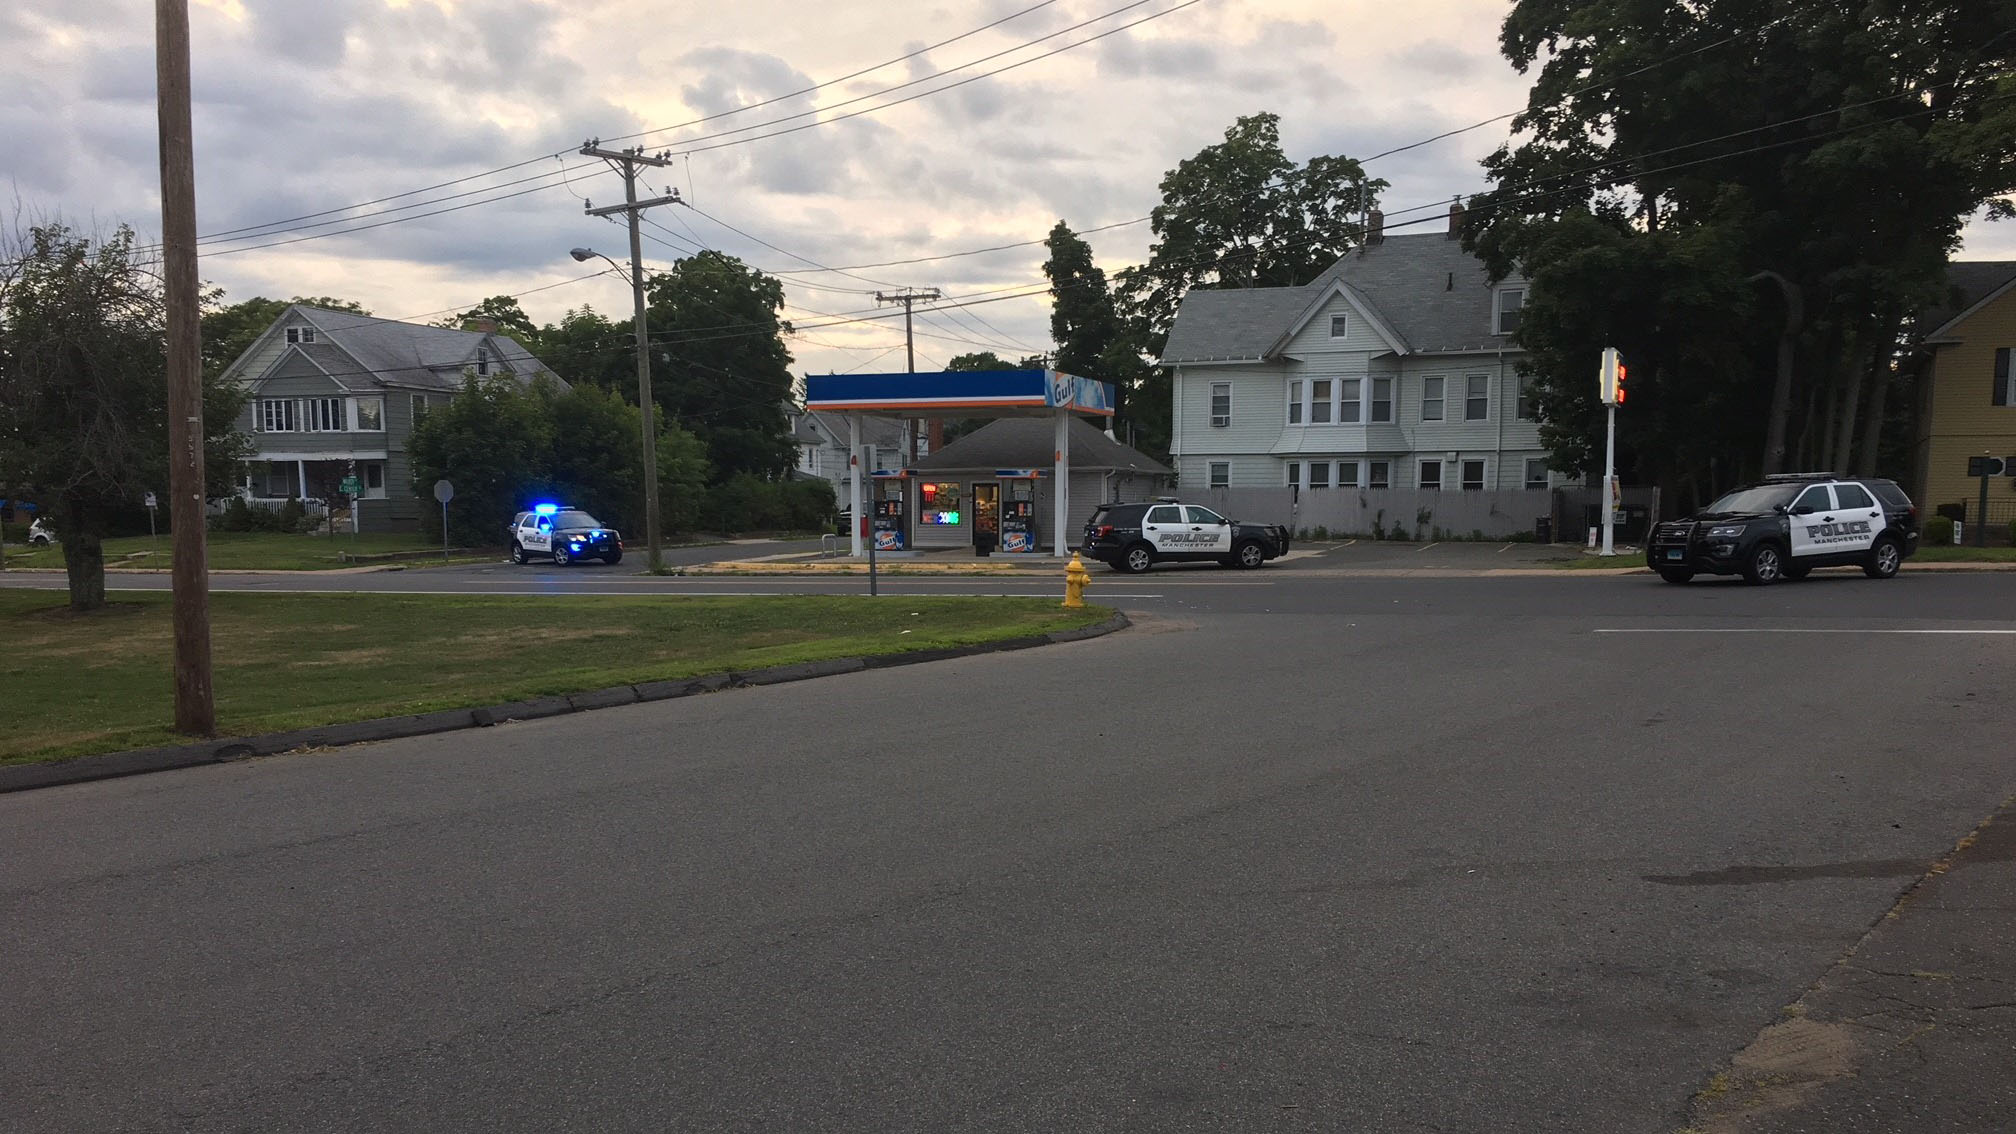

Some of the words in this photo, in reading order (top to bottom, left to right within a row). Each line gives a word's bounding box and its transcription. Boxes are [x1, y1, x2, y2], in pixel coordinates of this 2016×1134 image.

[1054, 376, 1074, 403] Gulf
[1806, 521, 1872, 538] POLICE
[523, 535, 547, 544] POLICE
[879, 536, 896, 546] Gulf
[1007, 538, 1025, 548] Gulf
[1158, 534, 1220, 543] POLICE
[1814, 534, 1870, 544] MANCHESTER
